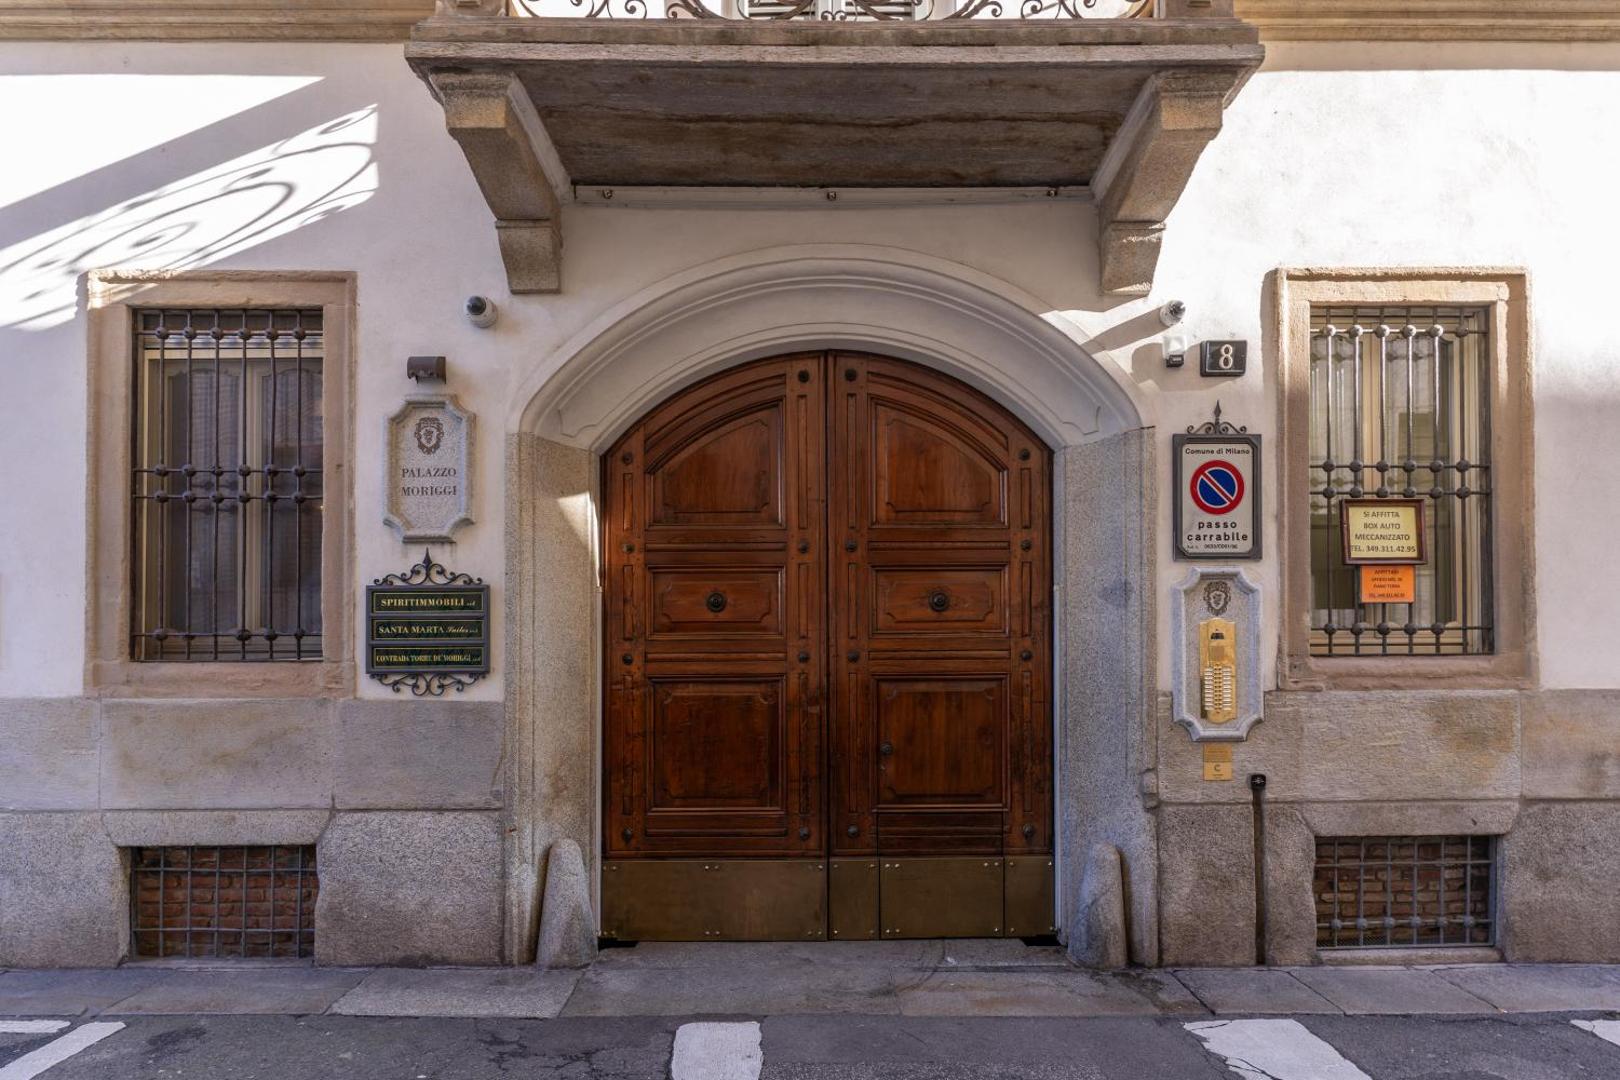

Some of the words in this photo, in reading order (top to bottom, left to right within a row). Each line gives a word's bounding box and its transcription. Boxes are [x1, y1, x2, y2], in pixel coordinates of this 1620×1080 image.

[1219, 344, 1233, 369] 8
[1185, 447, 1215, 455] Comune
[1216, 447, 1224, 455] di
[1225, 447, 1250, 455] Milano
[401, 467, 457, 478] PALAZZO
[401, 485, 457, 497] MORIGGI
[1198, 521, 1237, 530] passo
[1187, 532, 1248, 542] carrabile
[1366, 545, 1416, 553] 349.311.42.95
[381, 598, 465, 607] SPIRITIMMOBILI
[379, 625, 409, 634] SANTA
[411, 625, 444, 634] MARTA
